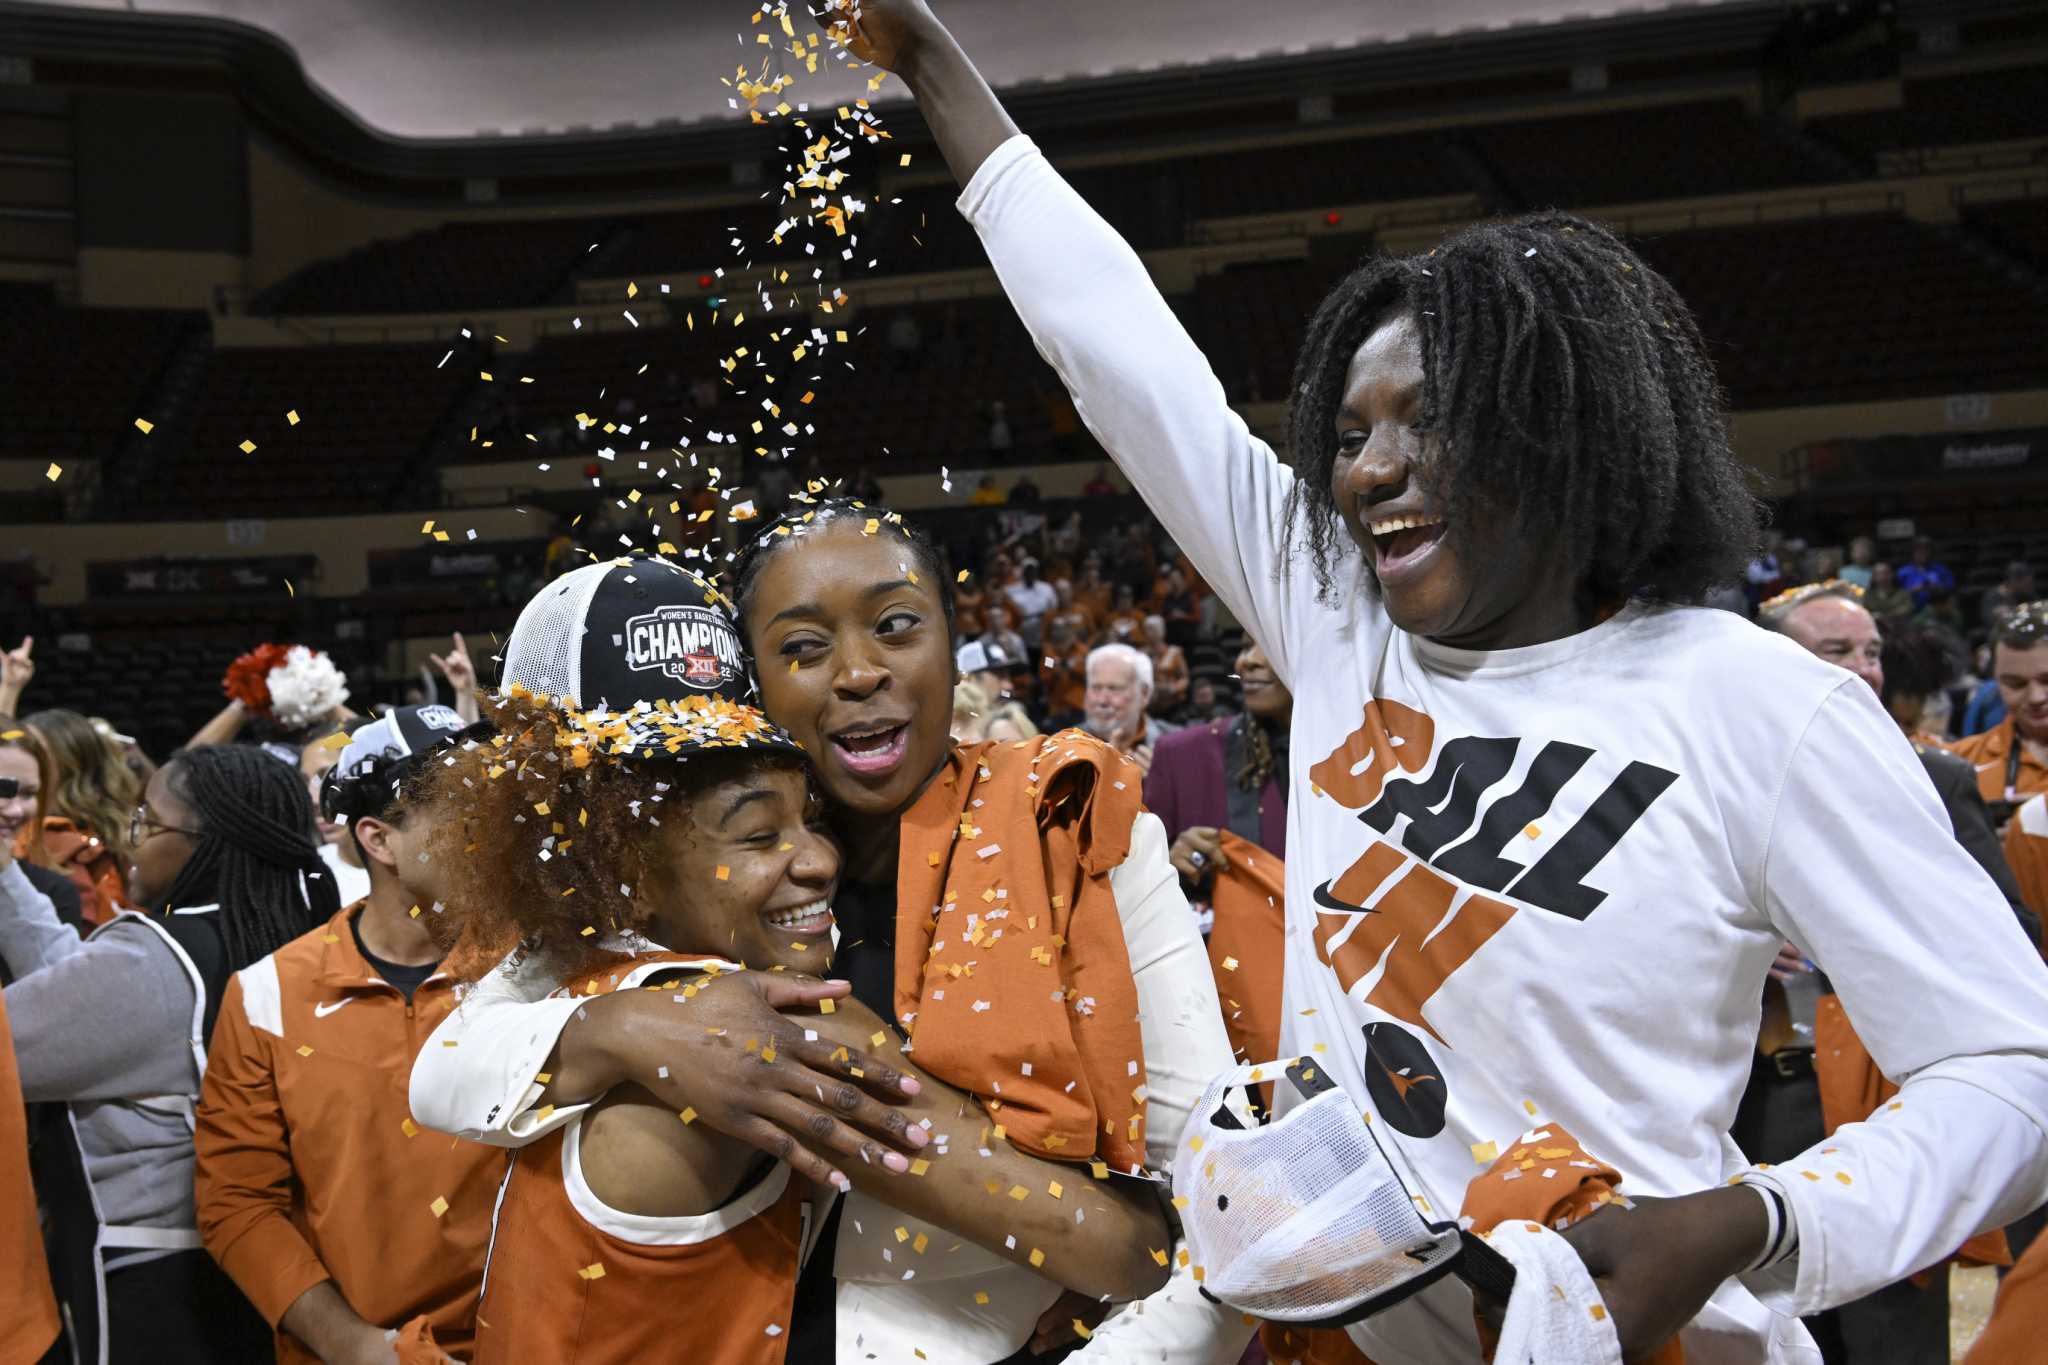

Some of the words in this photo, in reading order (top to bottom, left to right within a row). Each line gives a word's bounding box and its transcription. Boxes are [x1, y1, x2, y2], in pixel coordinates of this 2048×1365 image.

[660, 611, 692, 619] WOMEN'S
[671, 663, 685, 674] 20
[720, 666, 731, 677] 22
[1309, 698, 1681, 921] BALL
